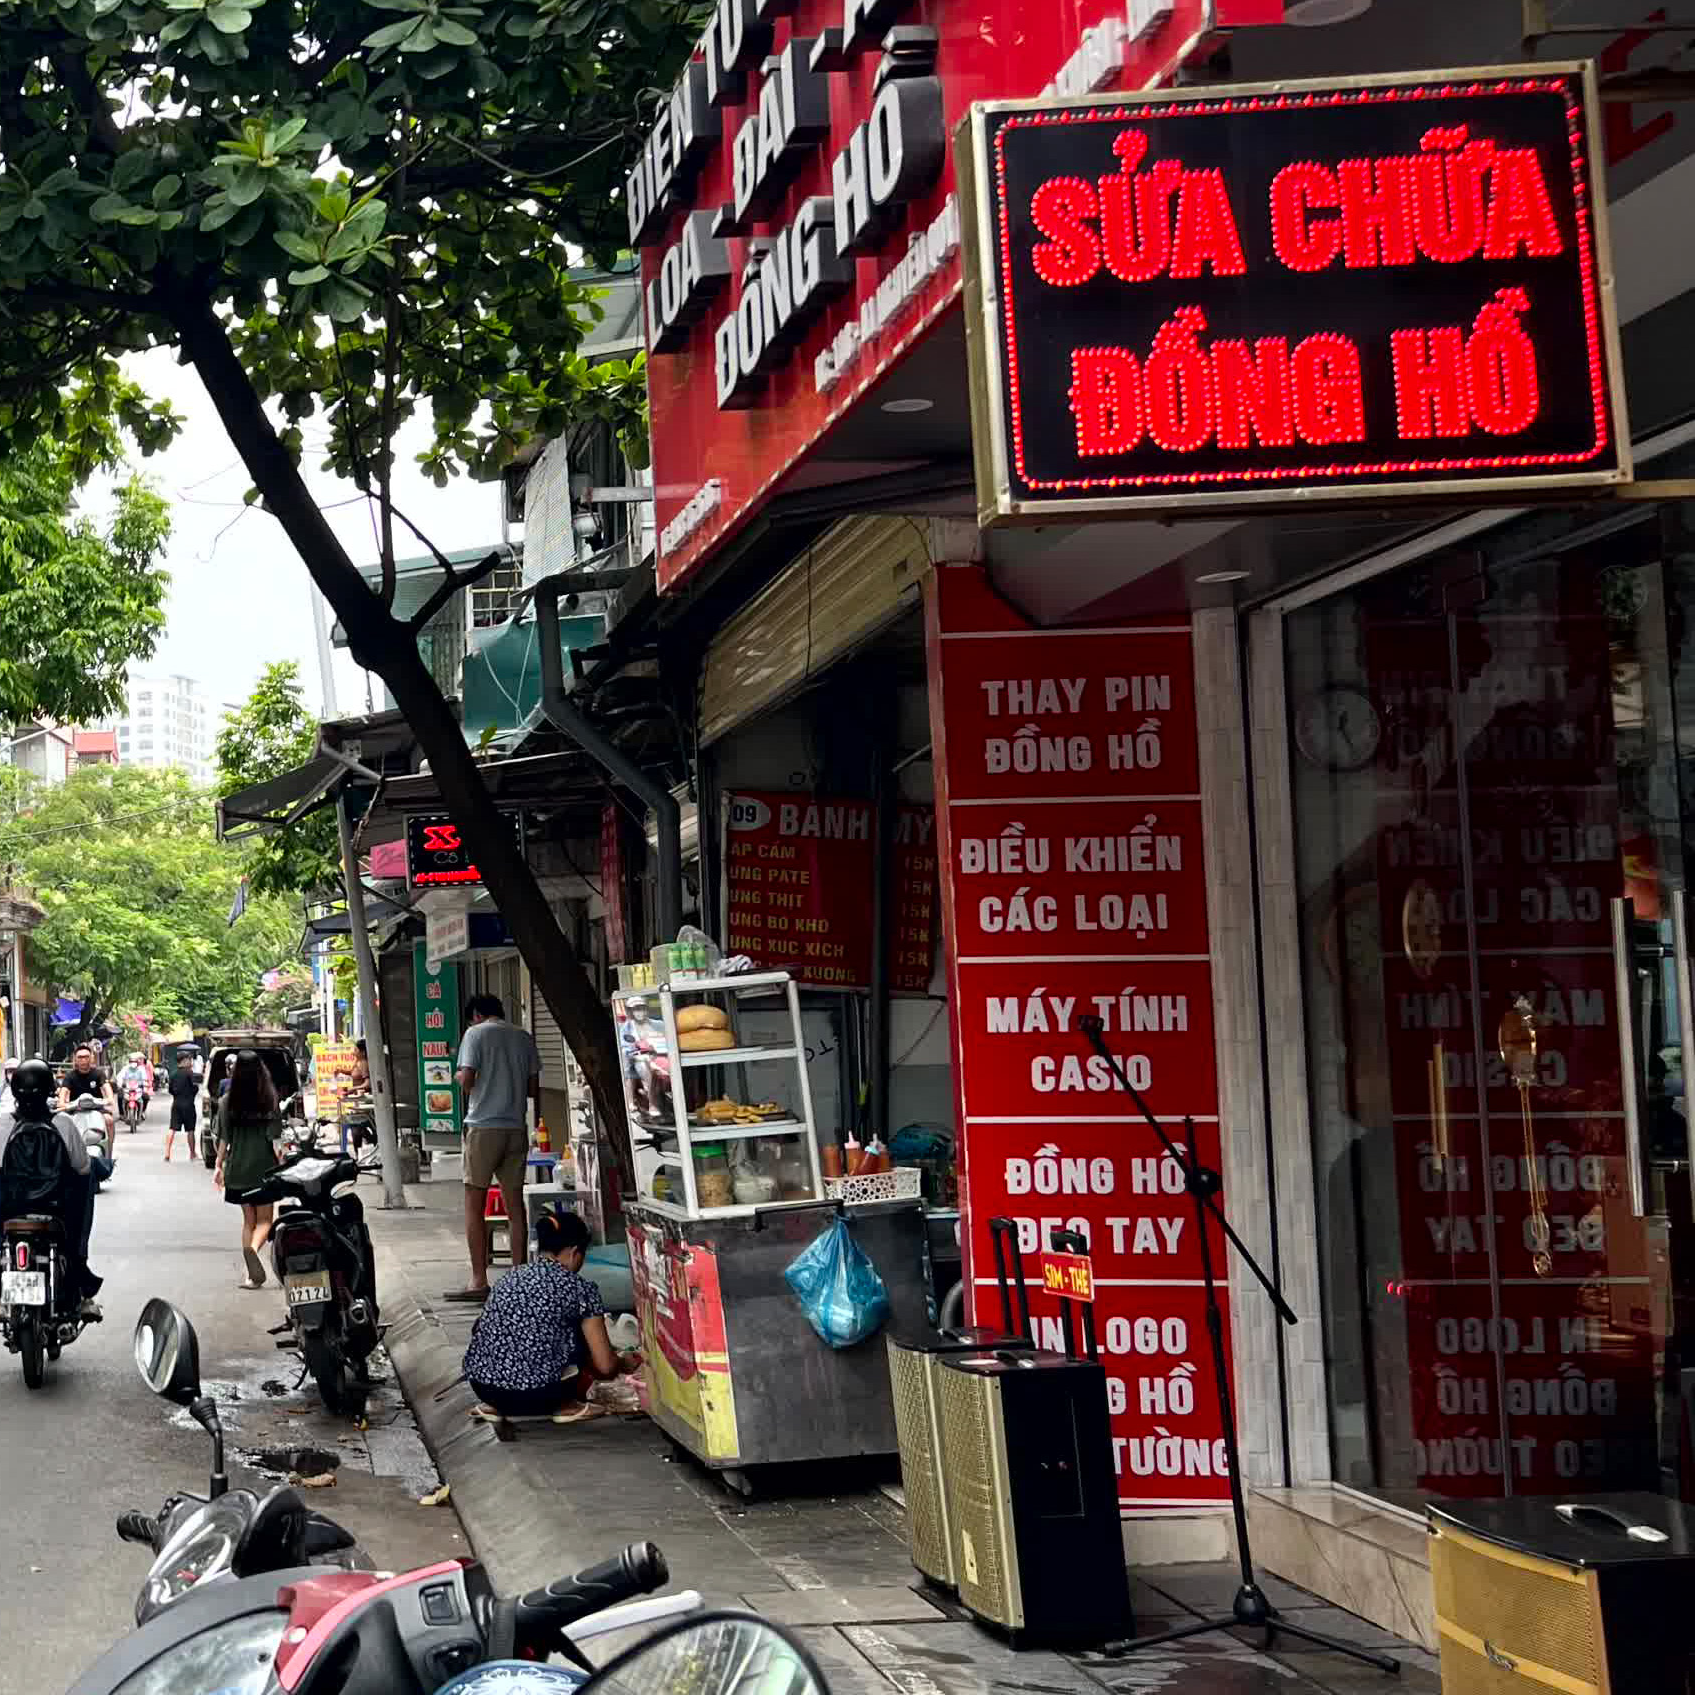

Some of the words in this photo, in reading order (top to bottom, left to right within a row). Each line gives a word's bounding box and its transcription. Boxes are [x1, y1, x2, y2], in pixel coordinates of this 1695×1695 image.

[627, 58, 694, 247] ĐIỆN
[647, 211, 702, 354] LOA
[733, 41, 796, 223] ĐÀI
[715, 197, 820, 409] ĐỒNG
[831, 33, 904, 258] HỒ
[1030, 127, 1248, 288] SỬA
[1270, 123, 1563, 273] CHỮA
[1067, 303, 1366, 457] ĐỒNG
[1391, 285, 1541, 441] HỒ
[980, 678, 1087, 716] THAY
[1105, 675, 1171, 712] PIN
[985, 723, 1093, 774] ĐỒNG
[1108, 717, 1163, 770] HỒ
[732, 804, 757, 823] 09
[779, 797, 870, 840] BÁNH
[959, 821, 1051, 874] ĐIỀU
[1065, 813, 1183, 873] KHIỂN
[979, 886, 1058, 933] CÁC
[1075, 892, 1169, 940] LOẠI
[986, 986, 1077, 1034] MÁY
[1091, 986, 1188, 1032] TÍNH
[1031, 1055, 1153, 1092] CASIO
[1004, 1143, 1115, 1195] ĐỒNG
[1131, 1142, 1189, 1195] HỒ
[1105, 1216, 1186, 1255] TAY
[1045, 1262, 1064, 1290] SIM
[1068, 1260, 1090, 1295] THẺ
[1029, 1316, 1066, 1355] IN
[1139, 1361, 1198, 1416] HỒ
[1111, 1426, 1230, 1477] TƯỜNG
